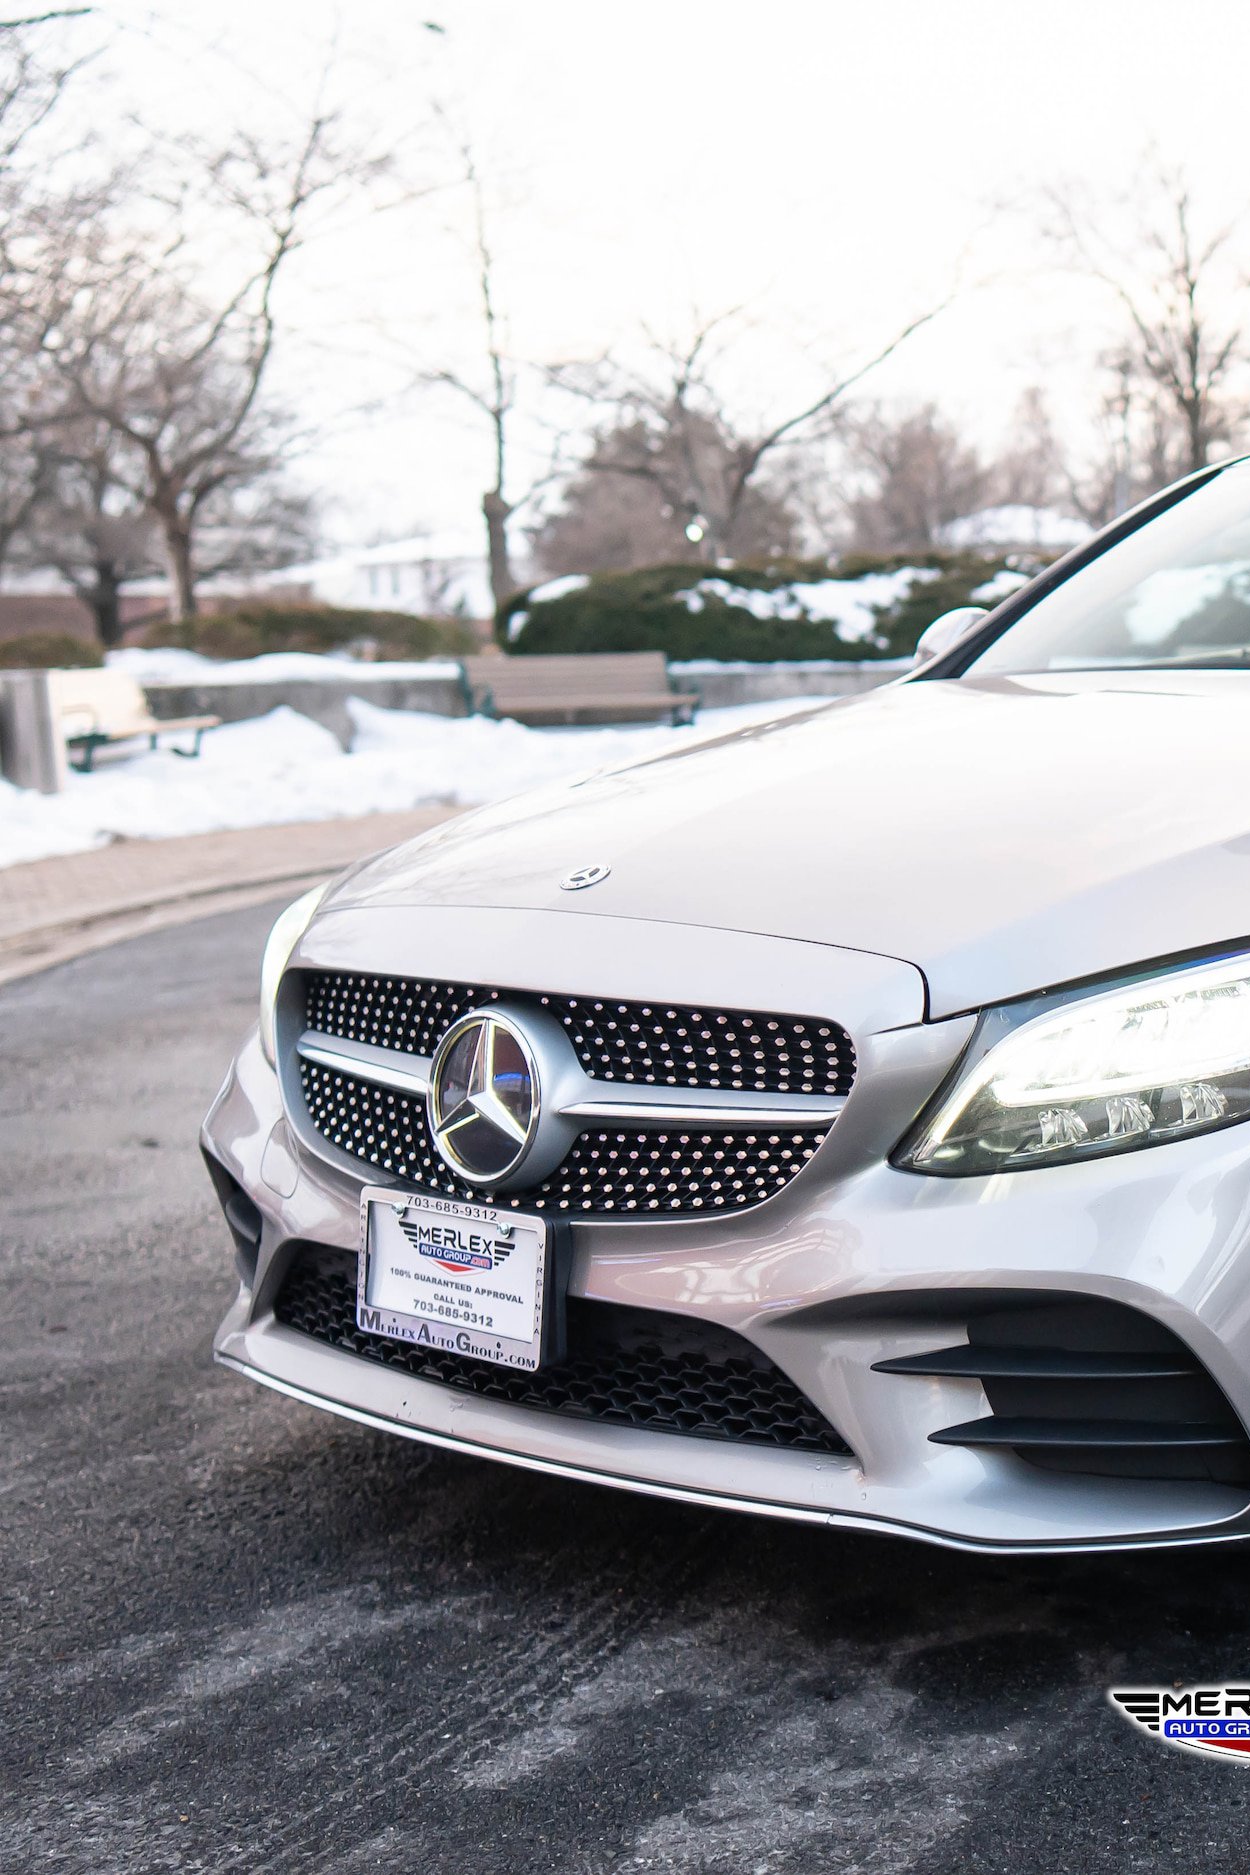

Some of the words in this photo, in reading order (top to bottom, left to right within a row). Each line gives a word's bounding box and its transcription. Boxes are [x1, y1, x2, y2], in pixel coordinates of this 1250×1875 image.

[406, 1195, 497, 1222] 703-685-9312
[418, 1225, 493, 1256] MERLEX
[420, 1244, 443, 1257] AUTO
[390, 1267, 412, 1279] 100%
[413, 1273, 472, 1292] GUARANTEED
[474, 1287, 524, 1304] APPROVAL
[533, 1242, 544, 1335] VIRGINIA
[413, 1299, 493, 1328] 703-685-9312
[433, 1293, 456, 1305] CALL
[458, 1299, 473, 1309] US:
